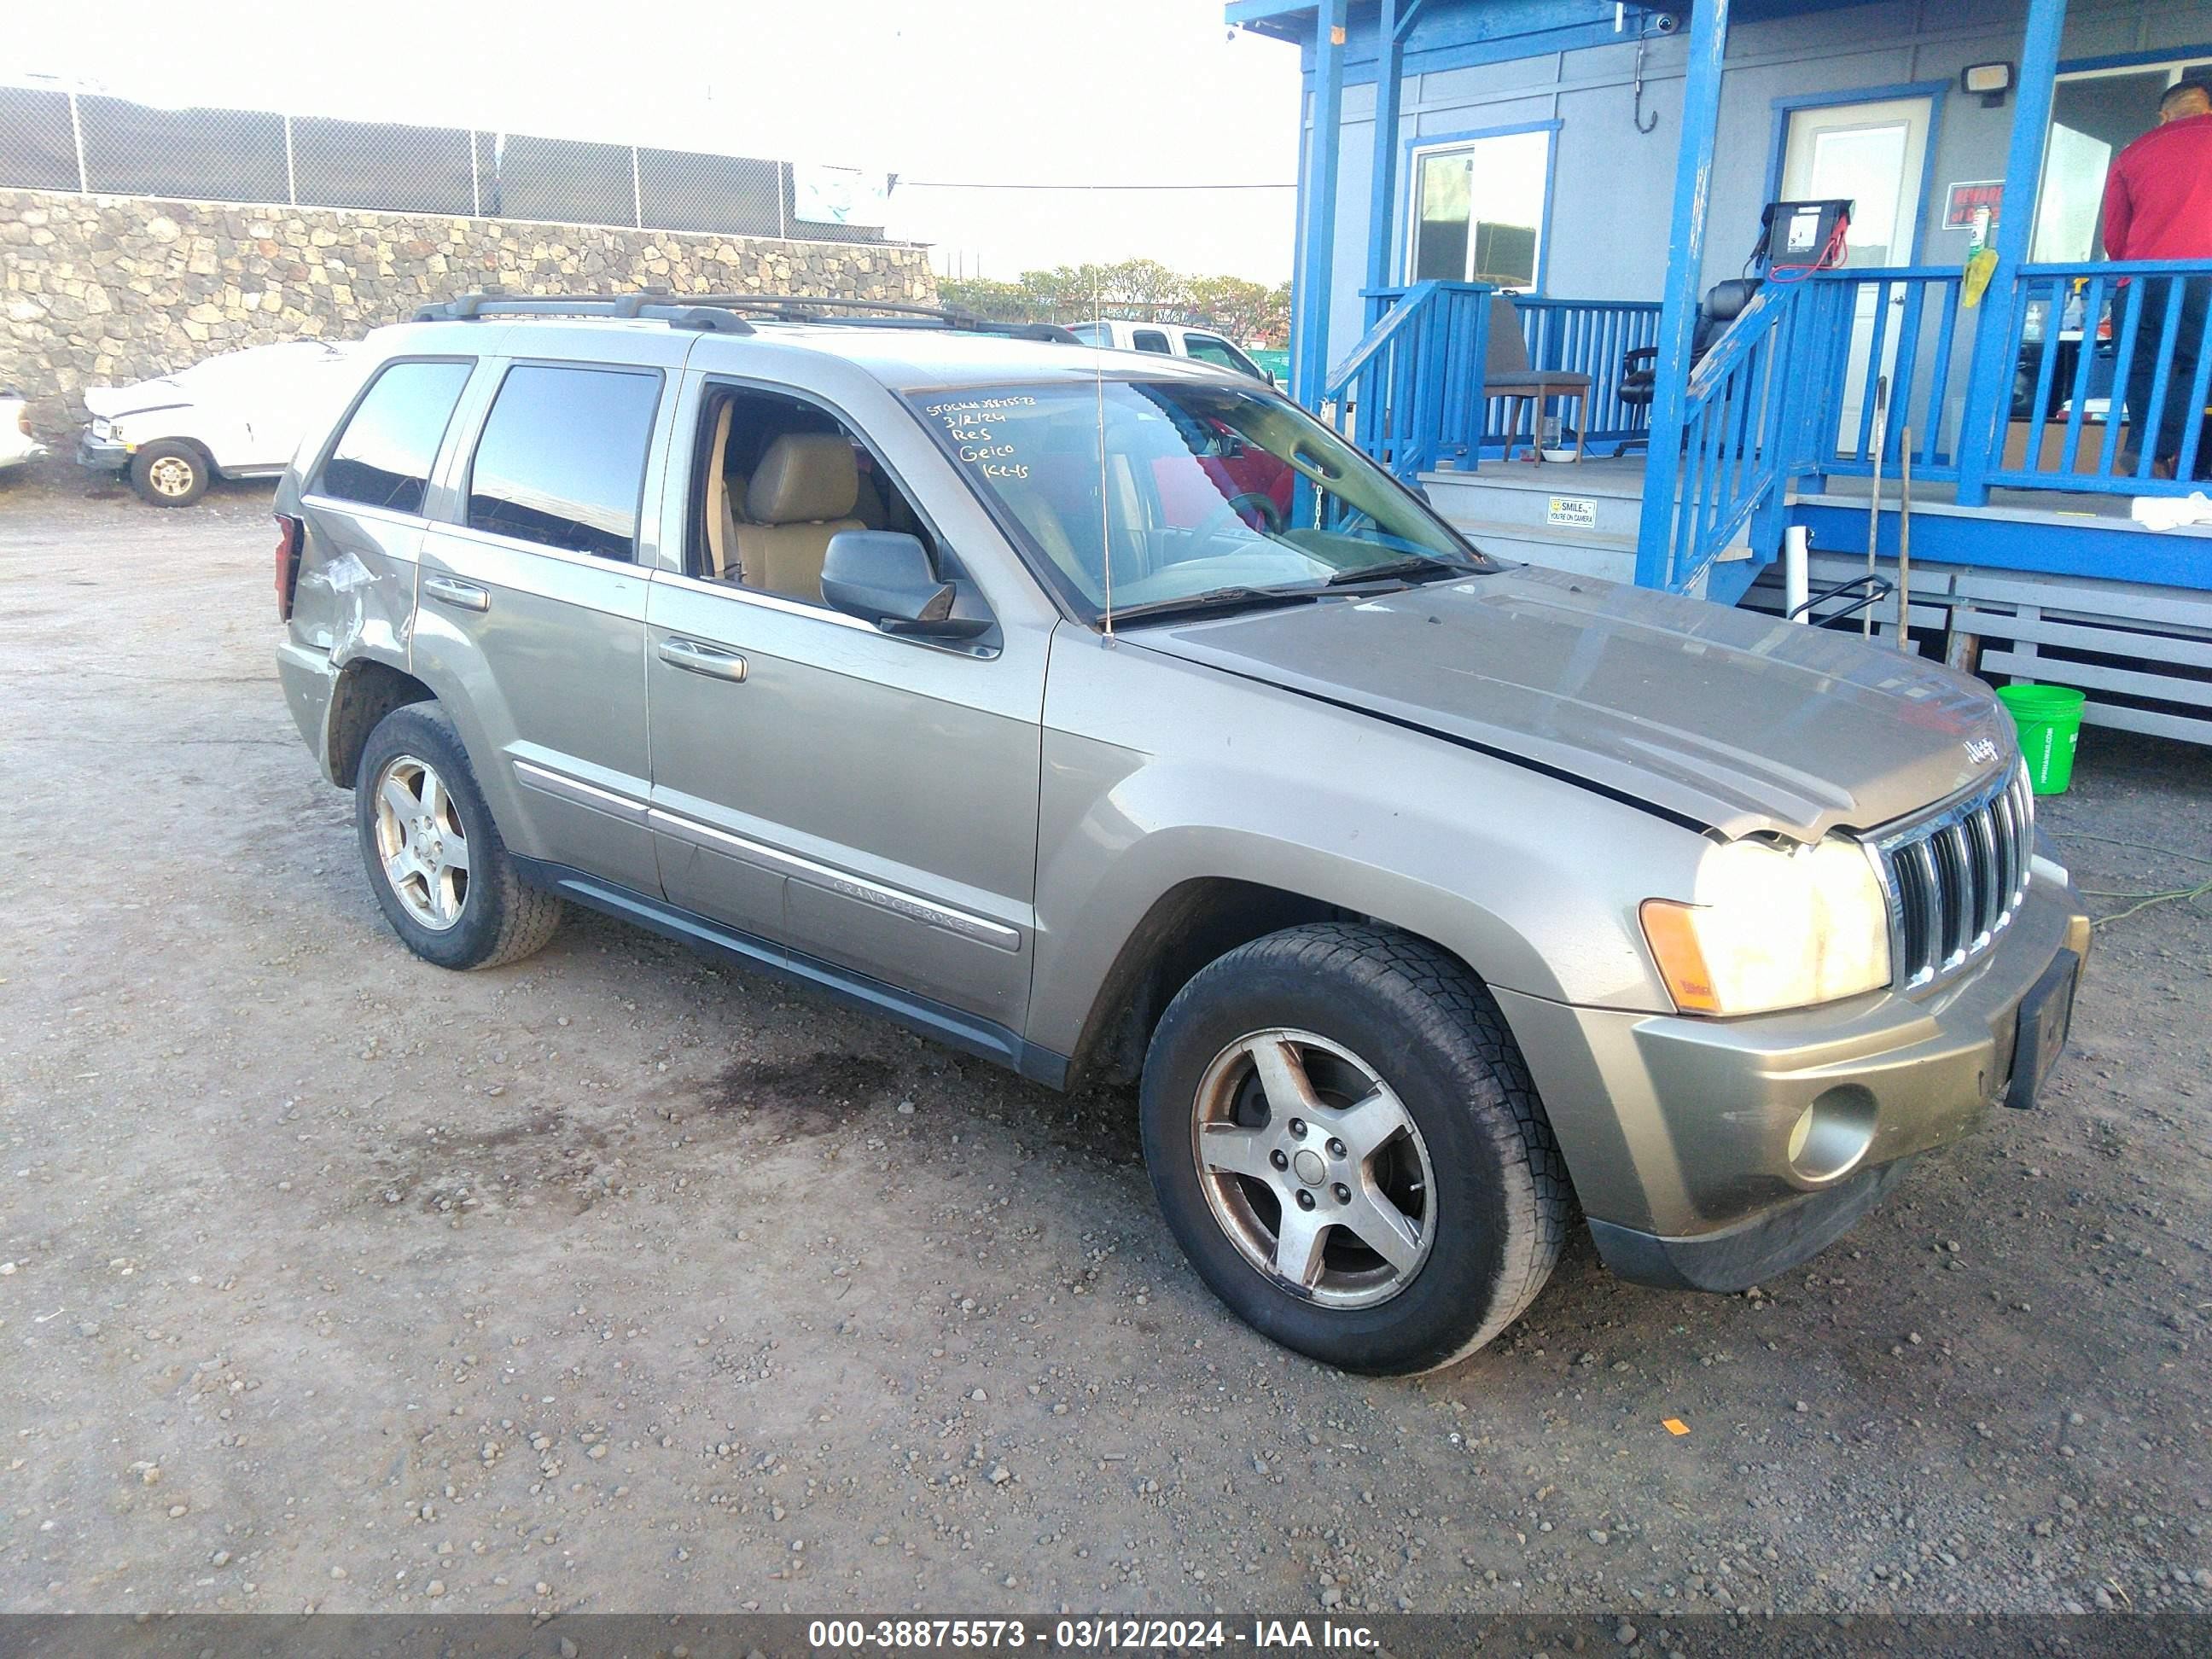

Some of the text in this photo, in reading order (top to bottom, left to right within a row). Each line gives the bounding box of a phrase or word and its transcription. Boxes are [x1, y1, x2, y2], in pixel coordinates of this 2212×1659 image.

[1574, 515, 1593, 523] CAMERA
[1963, 737, 1999, 764] Jeep
[834, 880, 976, 934] GRAND CHEROKEE
